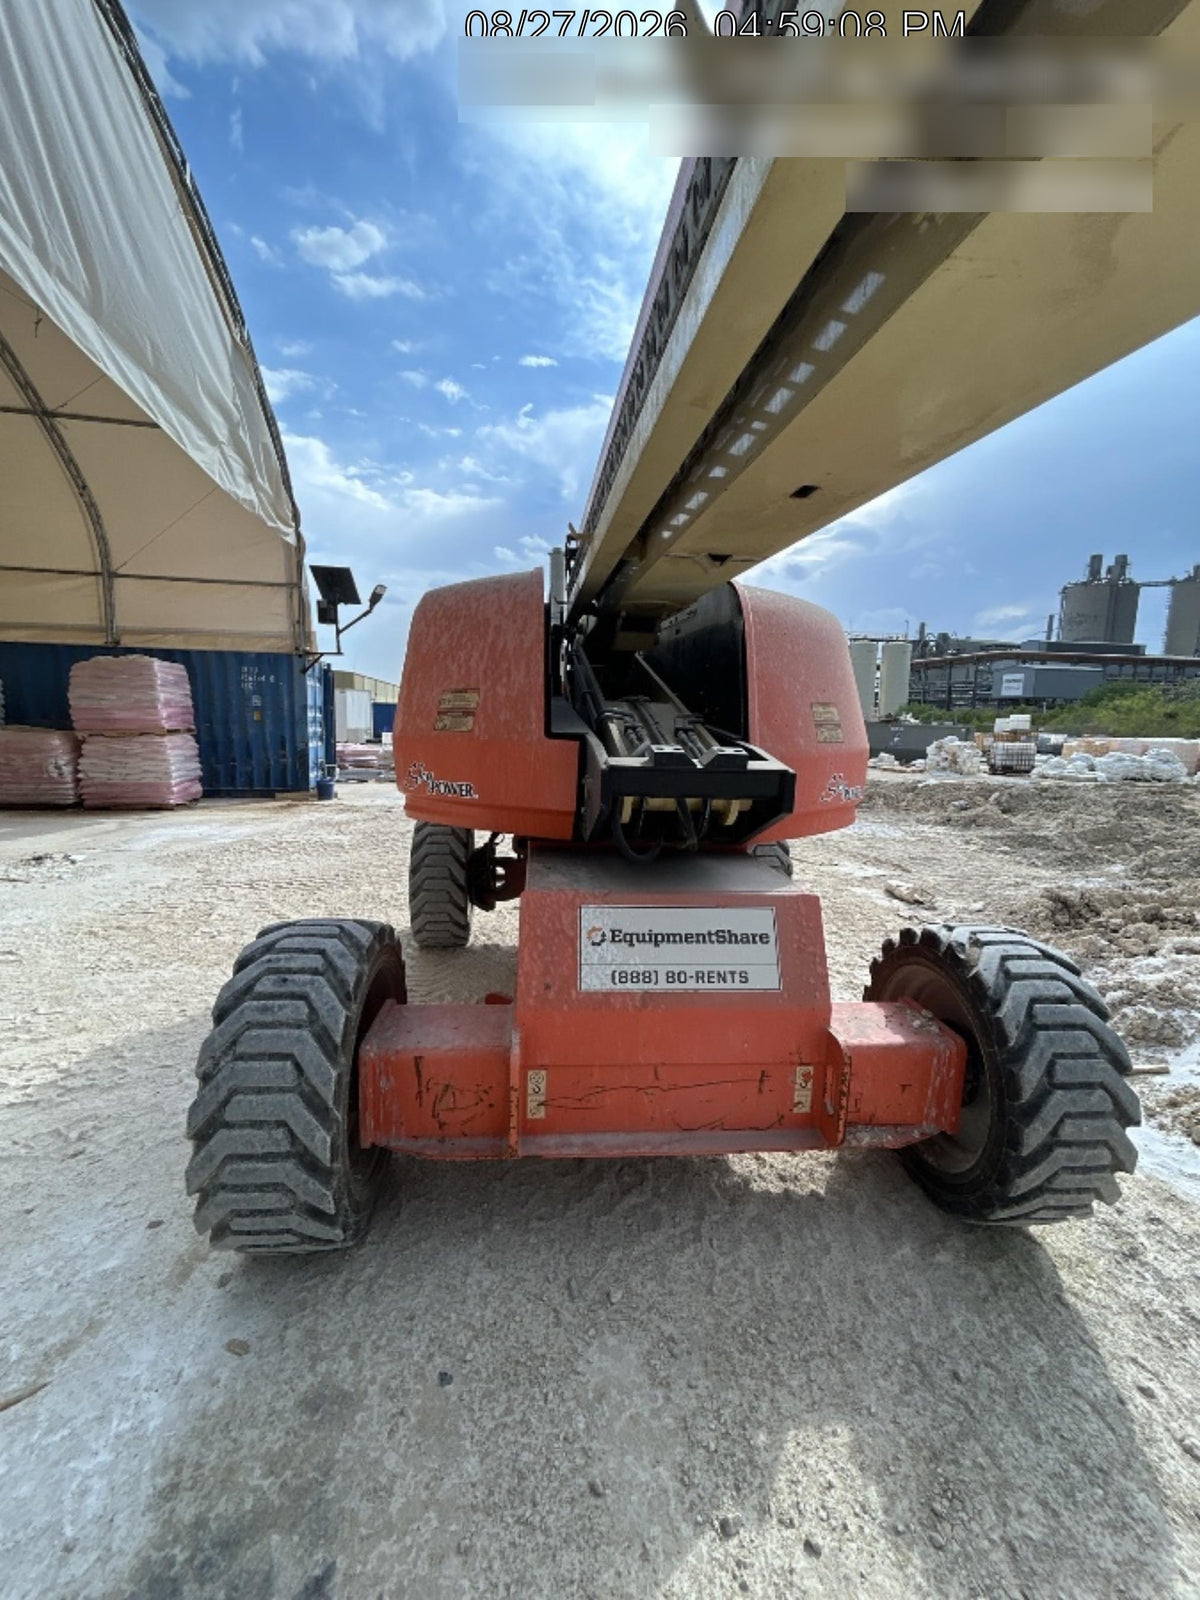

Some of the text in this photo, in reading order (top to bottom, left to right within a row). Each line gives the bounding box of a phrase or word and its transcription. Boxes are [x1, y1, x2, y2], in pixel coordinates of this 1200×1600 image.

[609, 929, 770, 948] EquipmentShare
[611, 970, 749, 985] (888) 80-RENTS
